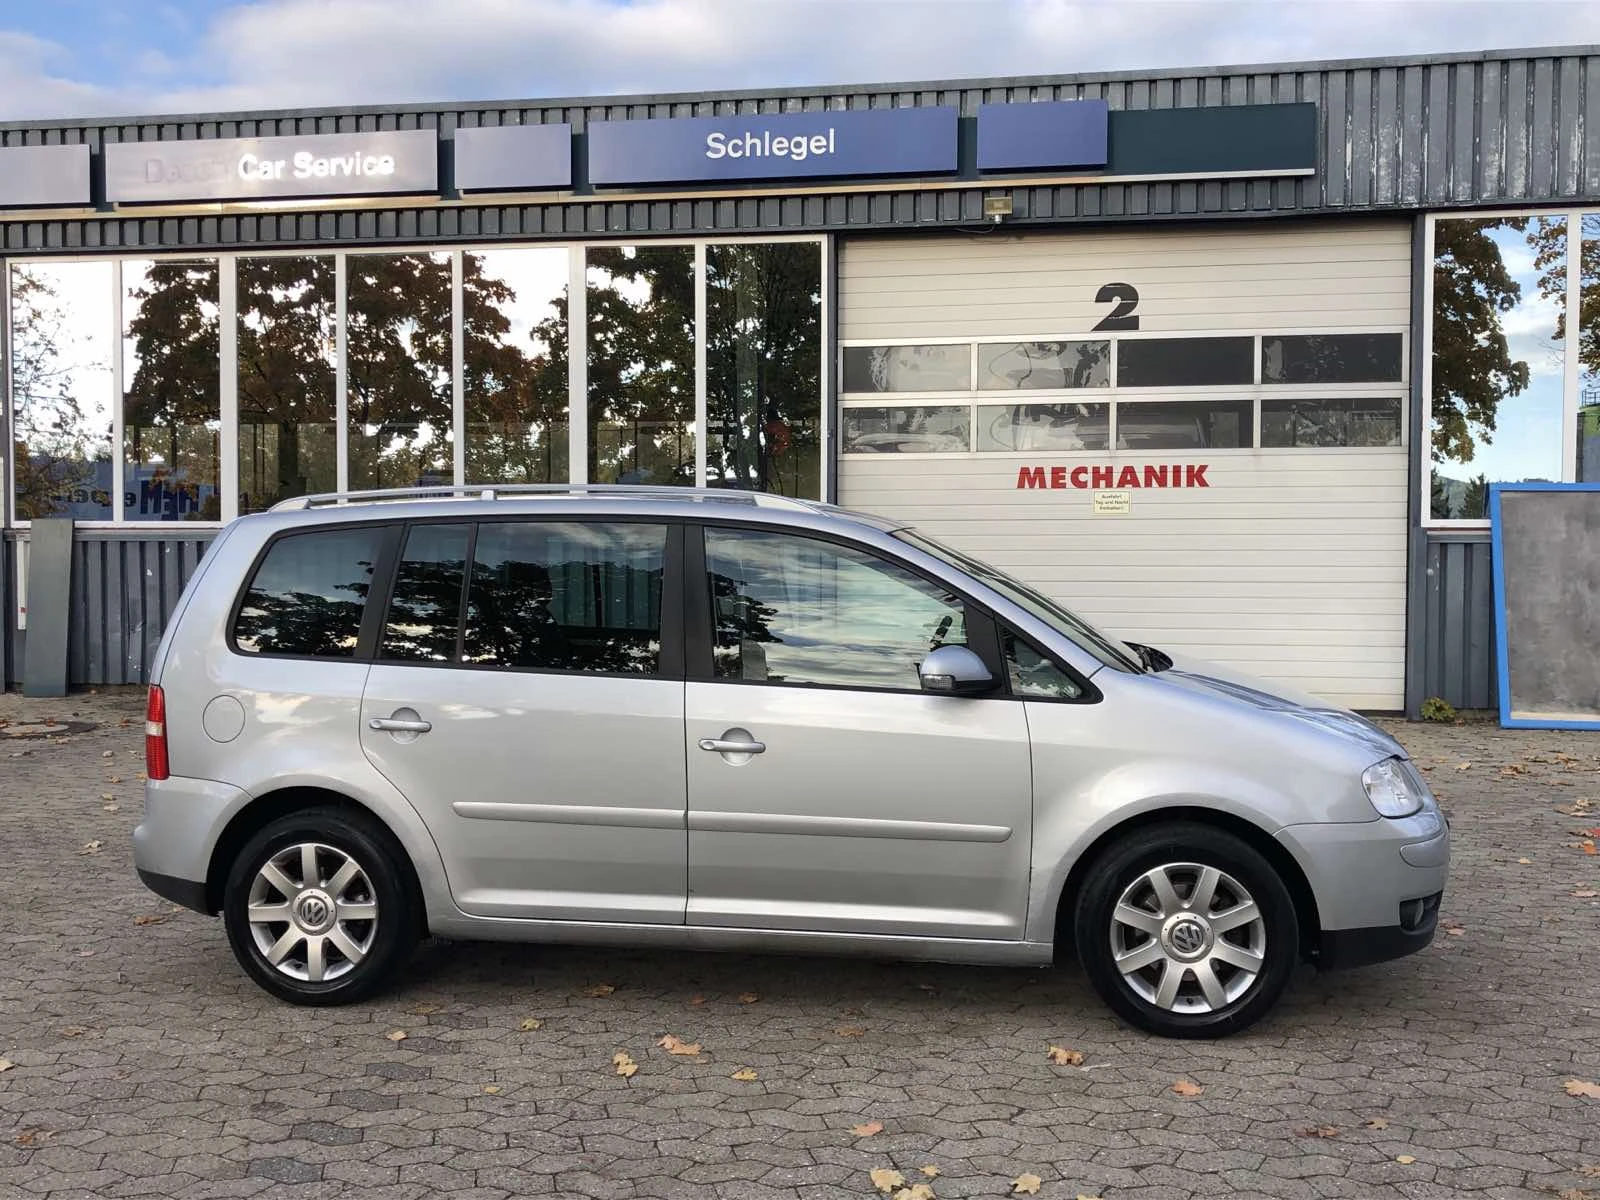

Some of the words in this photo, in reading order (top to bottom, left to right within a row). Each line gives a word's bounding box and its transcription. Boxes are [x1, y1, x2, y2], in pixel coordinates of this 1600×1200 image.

[706, 128, 835, 161] Schlegel
[237, 154, 286, 181] Car
[293, 151, 395, 179] Service
[1091, 282, 1140, 332] 2
[1016, 464, 1210, 489] MECHANIK
